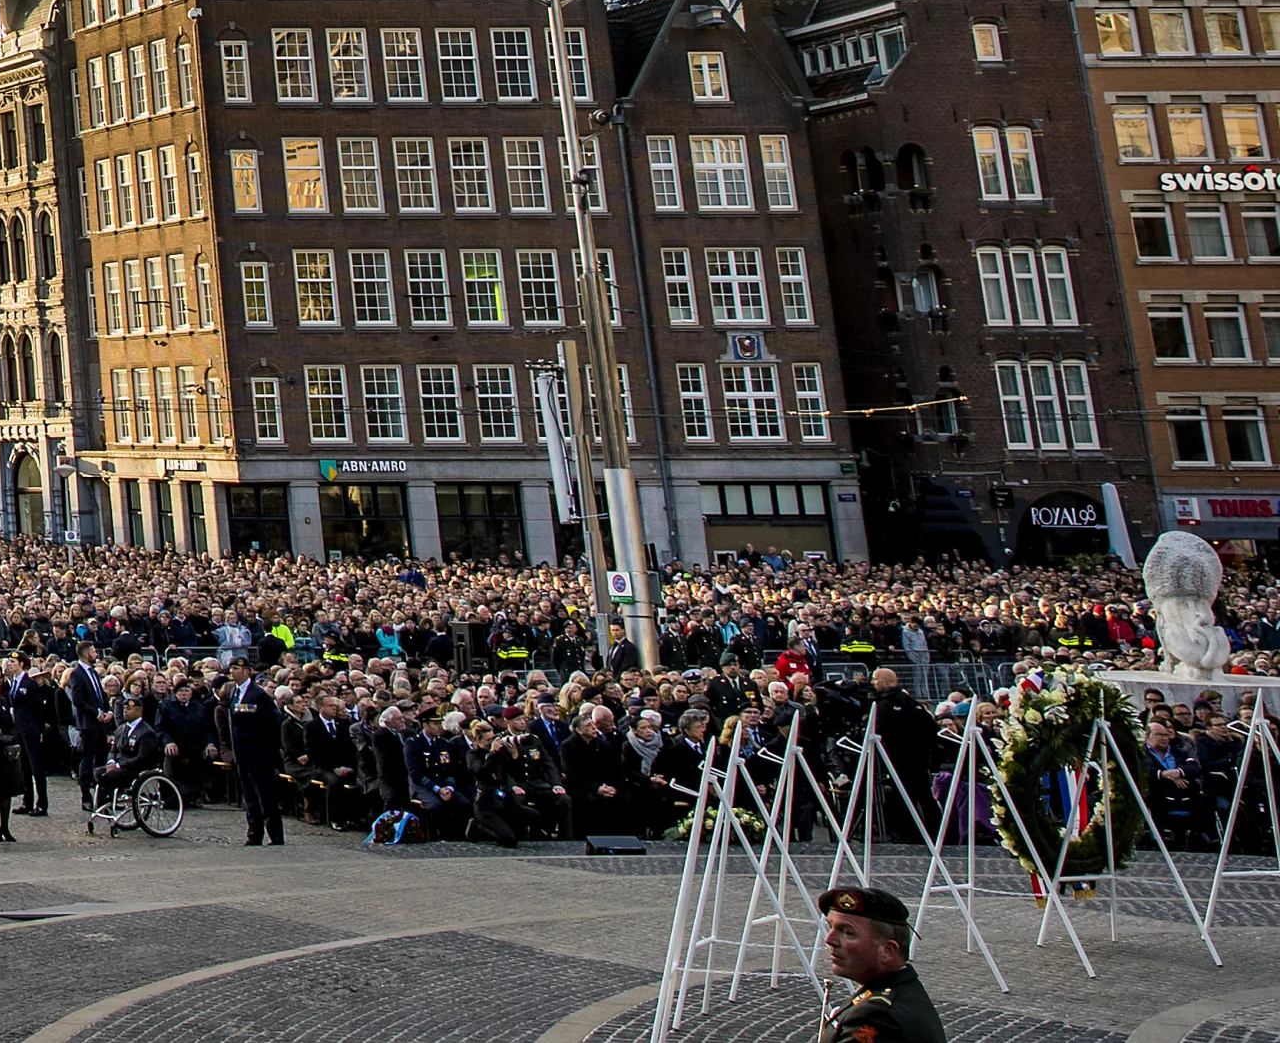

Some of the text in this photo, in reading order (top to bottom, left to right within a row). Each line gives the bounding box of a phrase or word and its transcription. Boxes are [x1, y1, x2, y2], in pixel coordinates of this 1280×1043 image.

[1160, 165, 1280, 191] swissôt
[342, 460, 407, 472] ABN AMRO
[1207, 498, 1274, 517] TOURS
